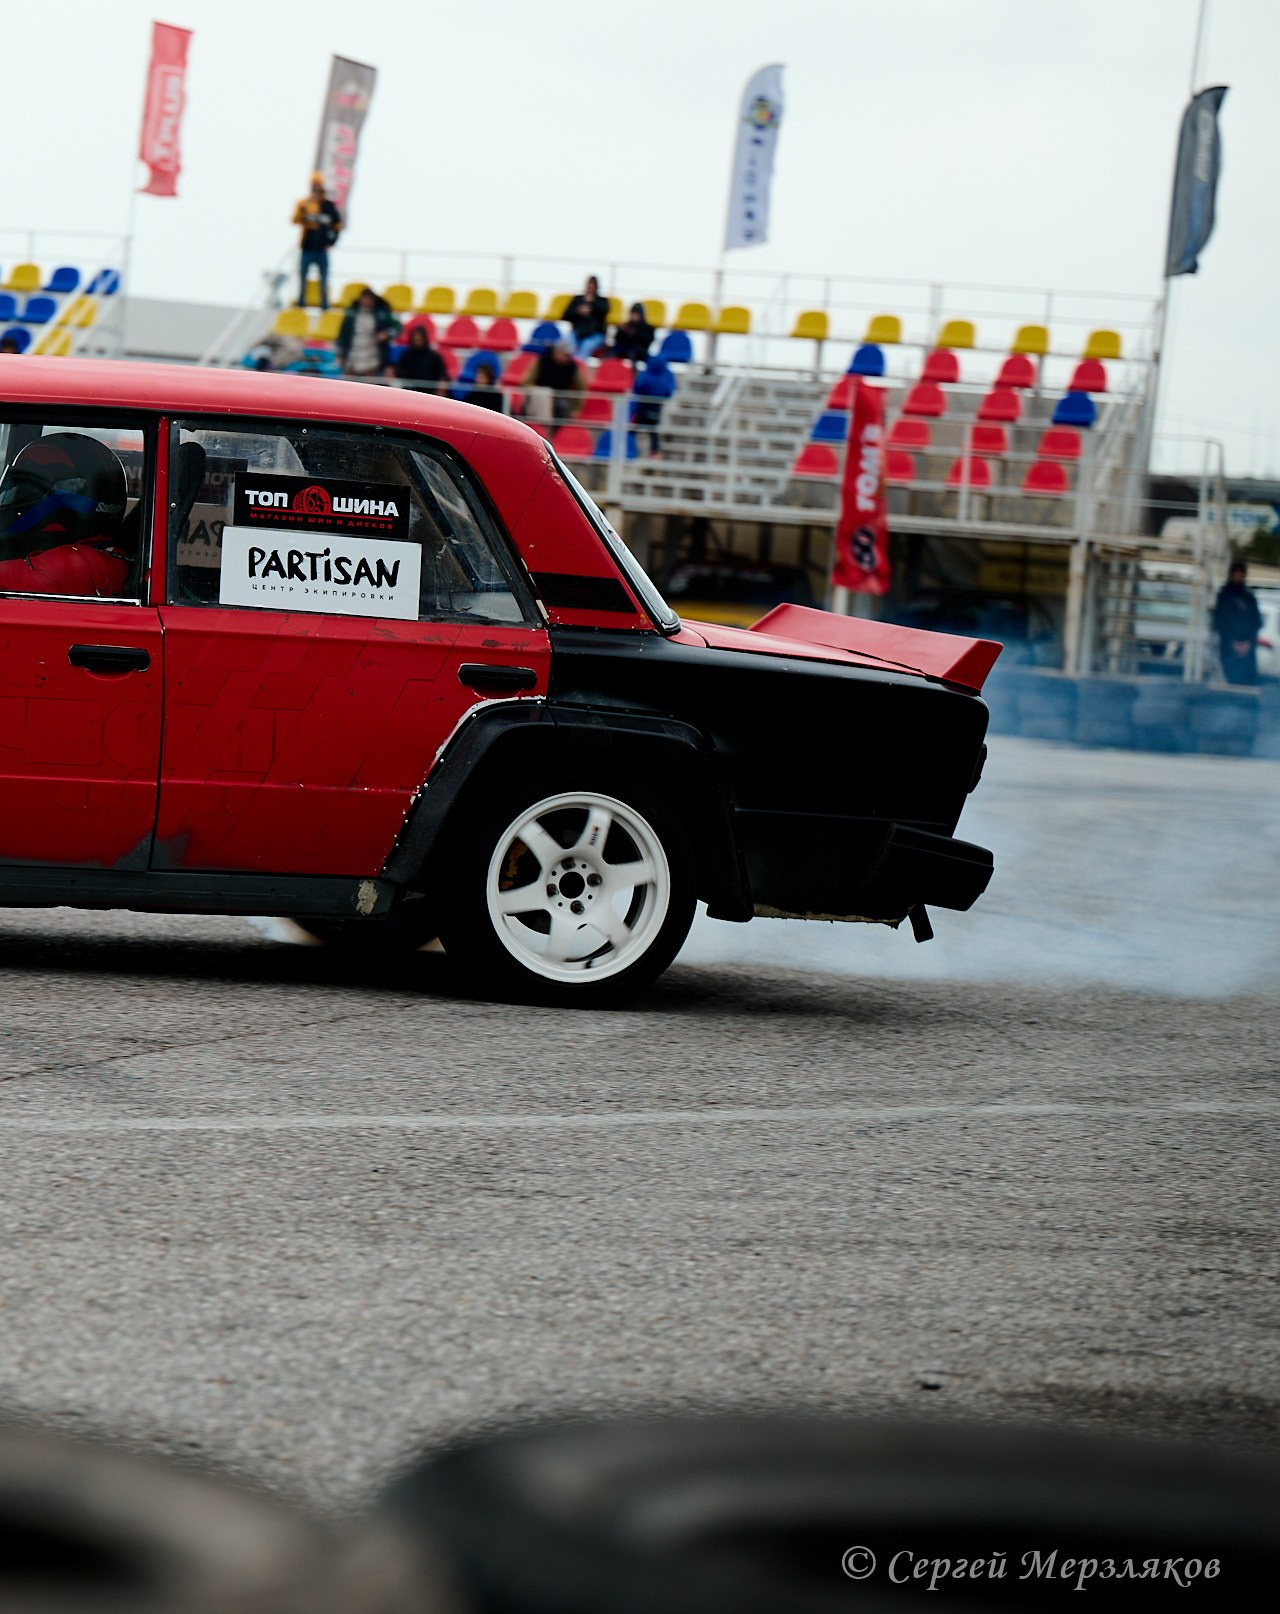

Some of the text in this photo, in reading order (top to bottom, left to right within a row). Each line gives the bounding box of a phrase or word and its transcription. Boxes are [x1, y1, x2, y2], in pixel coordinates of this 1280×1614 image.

[245, 490, 399, 517] ТОП ШИНА
[250, 513, 303, 522] МАГАЗИН
[347, 521, 393, 529] ДИСКОВ
[252, 584, 394, 600] ЦЕНТР ЭКИПИРОВКИ
